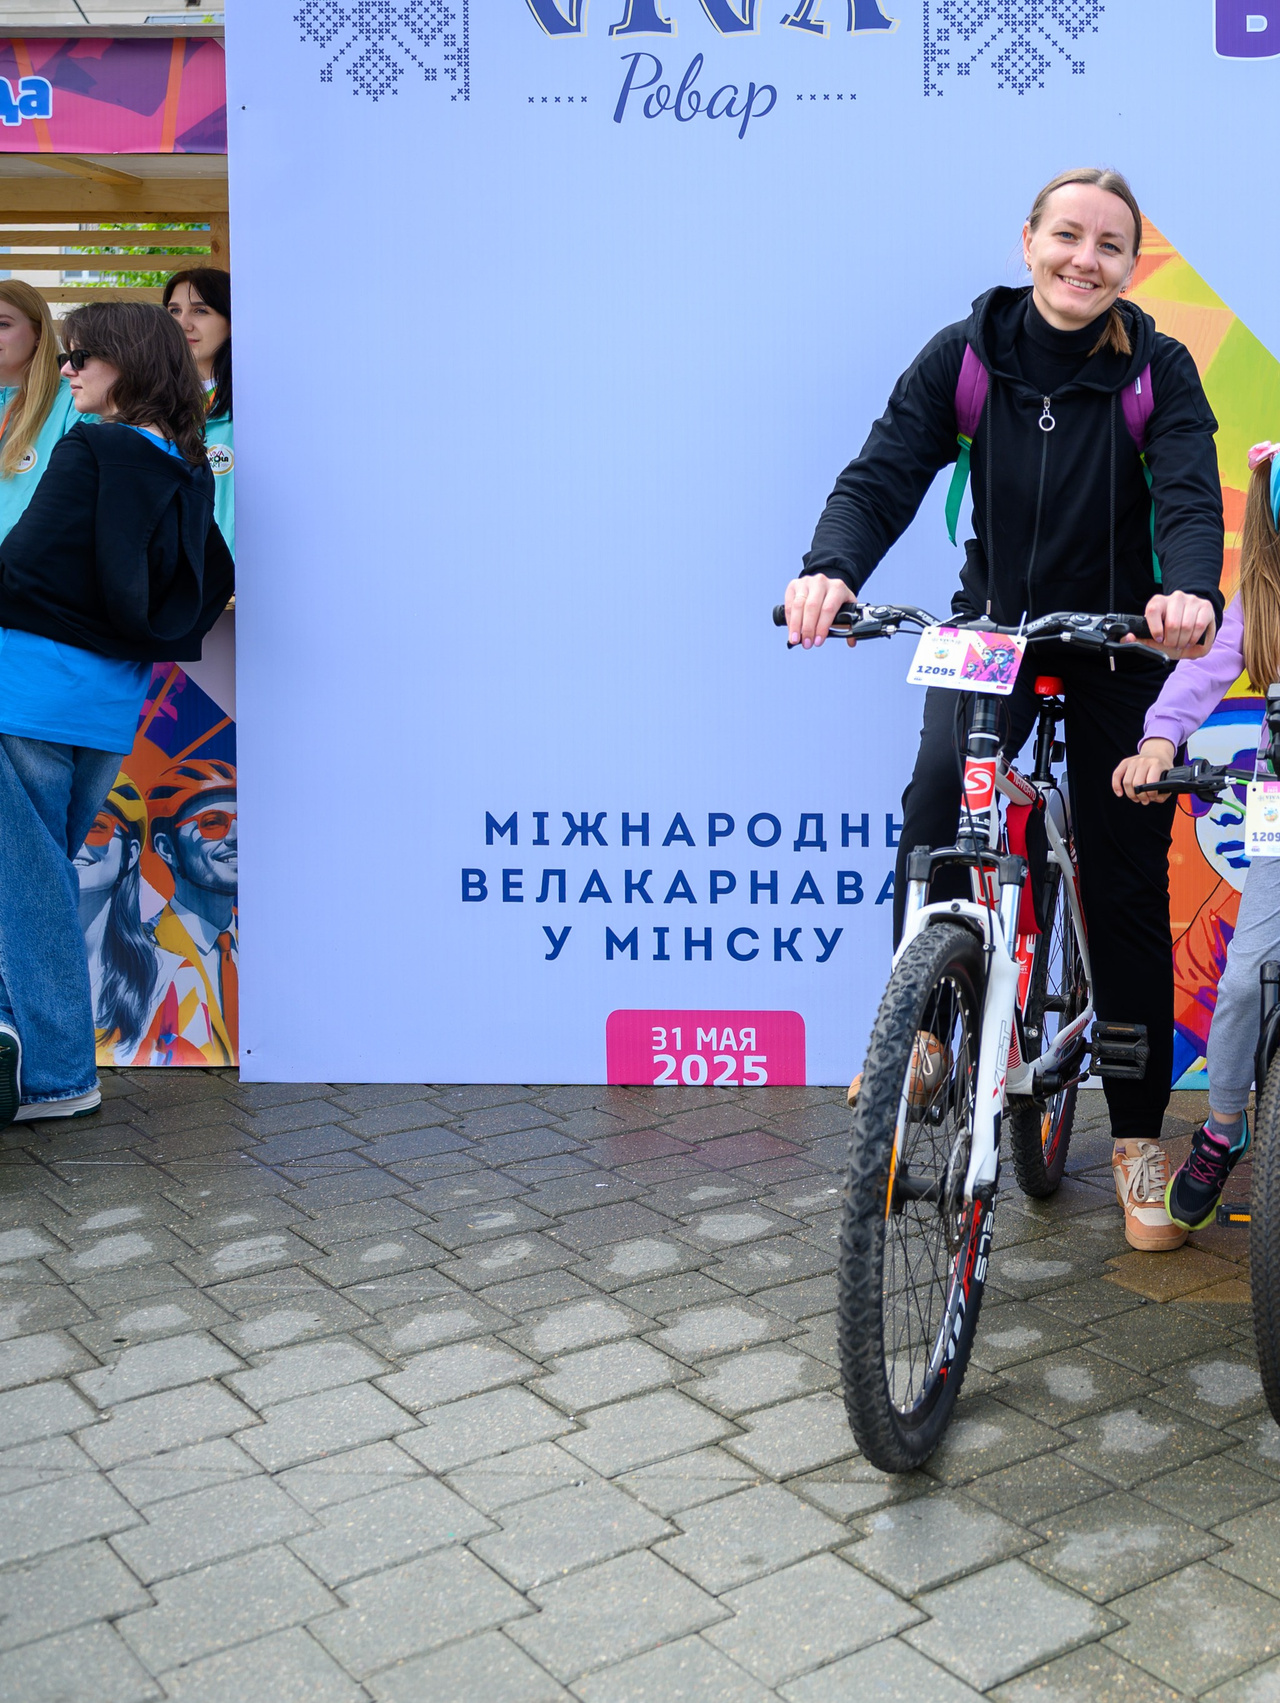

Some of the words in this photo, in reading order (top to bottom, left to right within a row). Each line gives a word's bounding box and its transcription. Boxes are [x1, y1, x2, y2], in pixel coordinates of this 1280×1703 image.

[613, 52, 777, 140] Ровар
[916, 665, 956, 677] 12095
[461, 868, 898, 905] ВЕЛАКАРНАВА
[542, 926, 572, 961] У
[605, 927, 844, 963] МІНСКУ
[651, 1027, 681, 1051] 31
[697, 1027, 756, 1051] МАЯ
[653, 1054, 768, 1086] 2025
